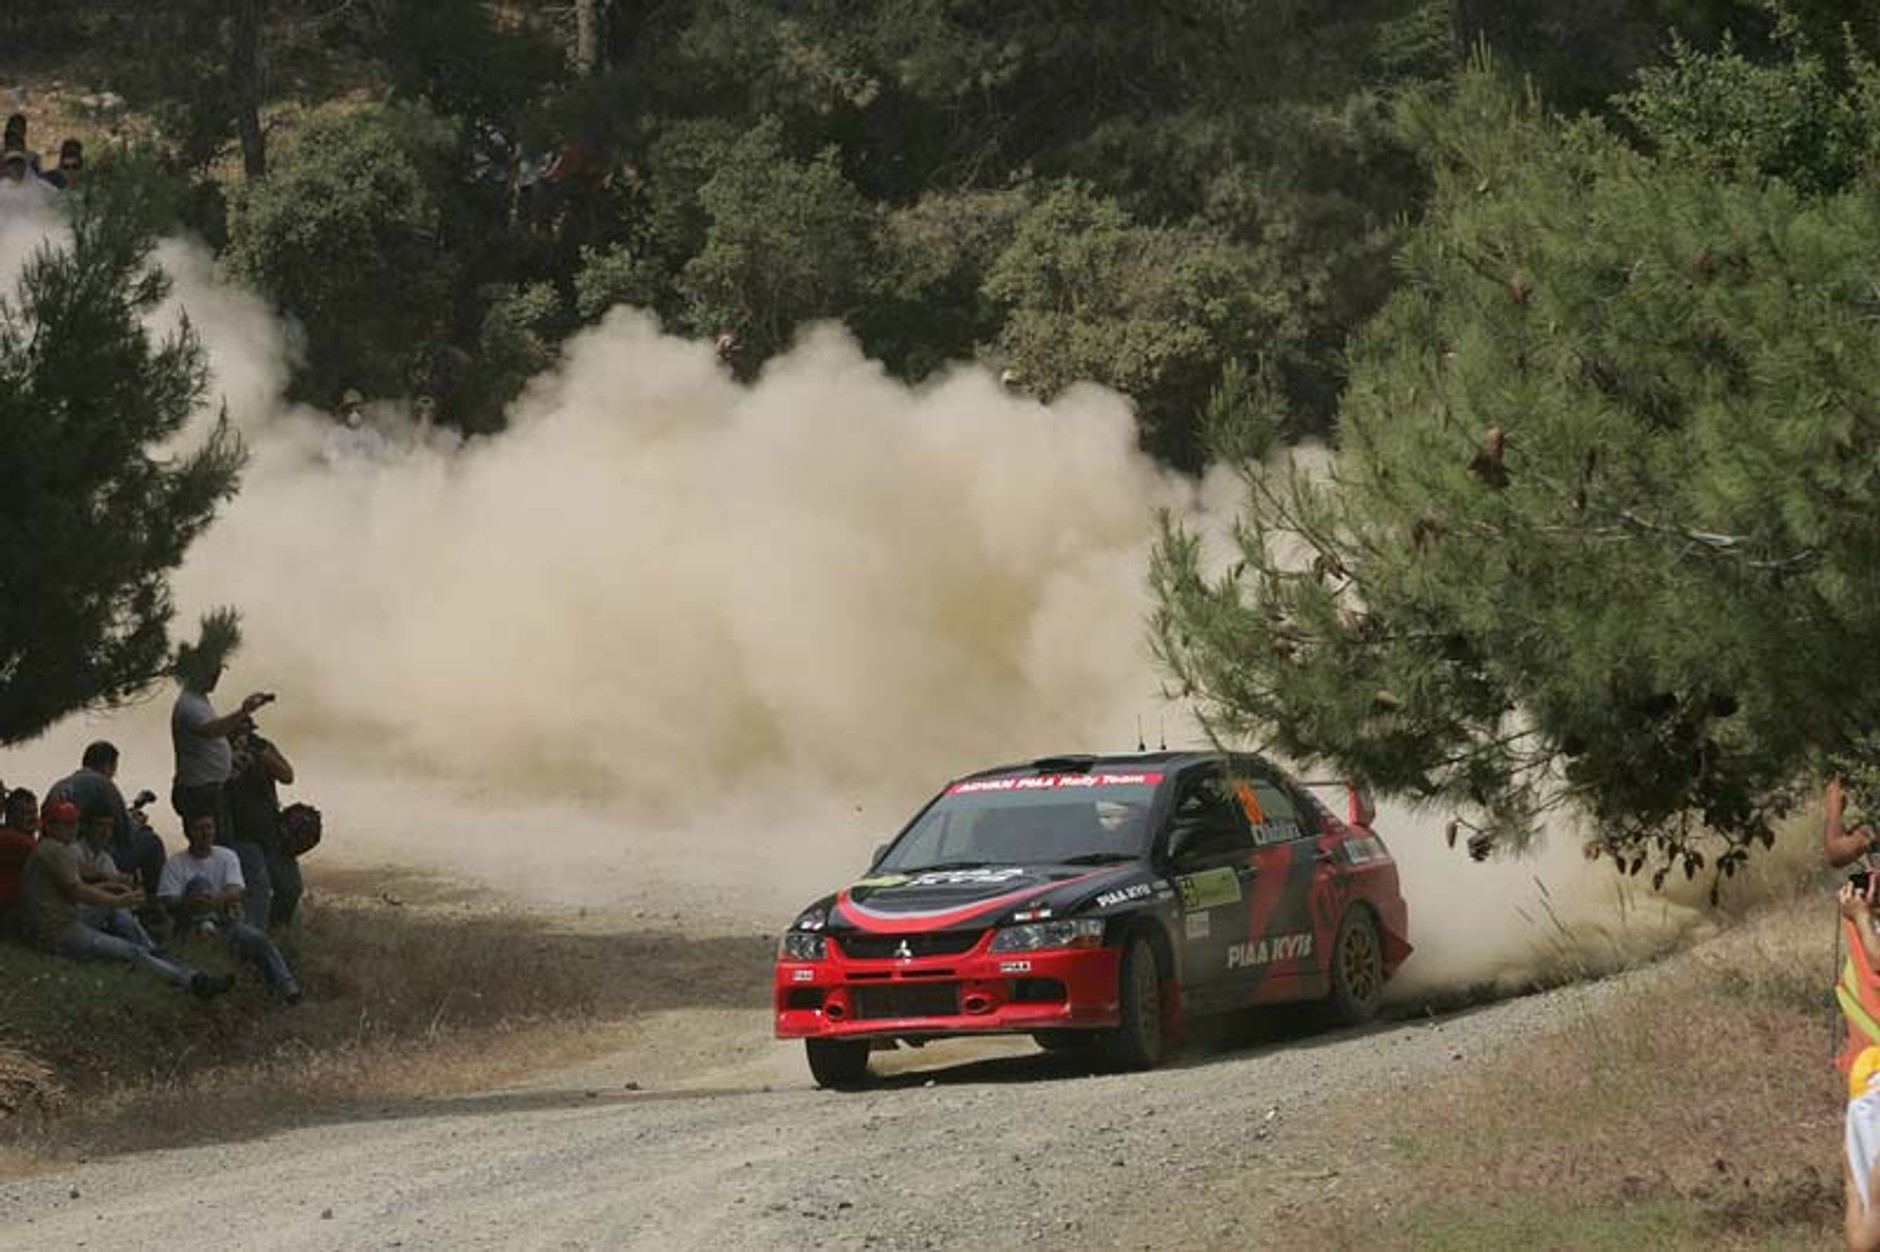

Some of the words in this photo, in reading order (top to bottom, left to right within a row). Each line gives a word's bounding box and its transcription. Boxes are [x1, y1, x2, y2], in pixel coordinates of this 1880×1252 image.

[1101, 774, 1145, 785] Team
[1227, 940, 1268, 969] PIAA
[1271, 933, 1313, 962] KYB
